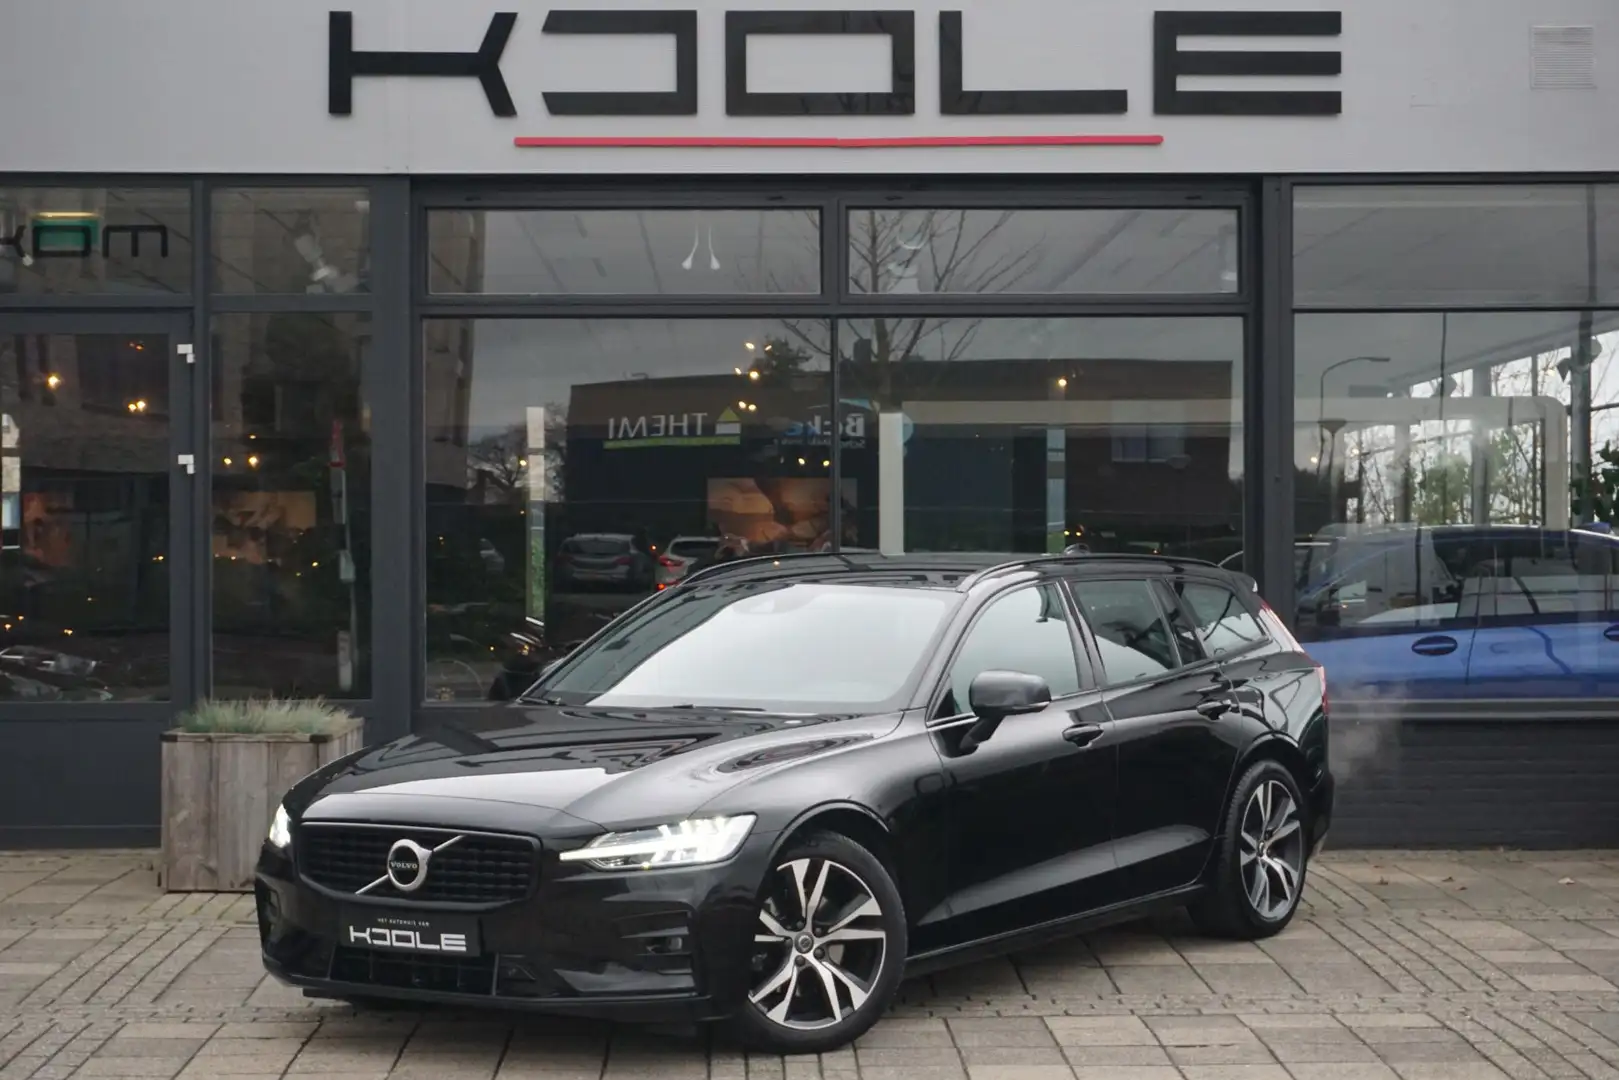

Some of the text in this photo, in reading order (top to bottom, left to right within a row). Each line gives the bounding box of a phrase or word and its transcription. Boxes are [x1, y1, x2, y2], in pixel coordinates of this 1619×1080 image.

[328, 9, 1342, 117] KOOLE
[390, 861, 418, 869] VOLVO
[349, 925, 467, 952] KOOLE
